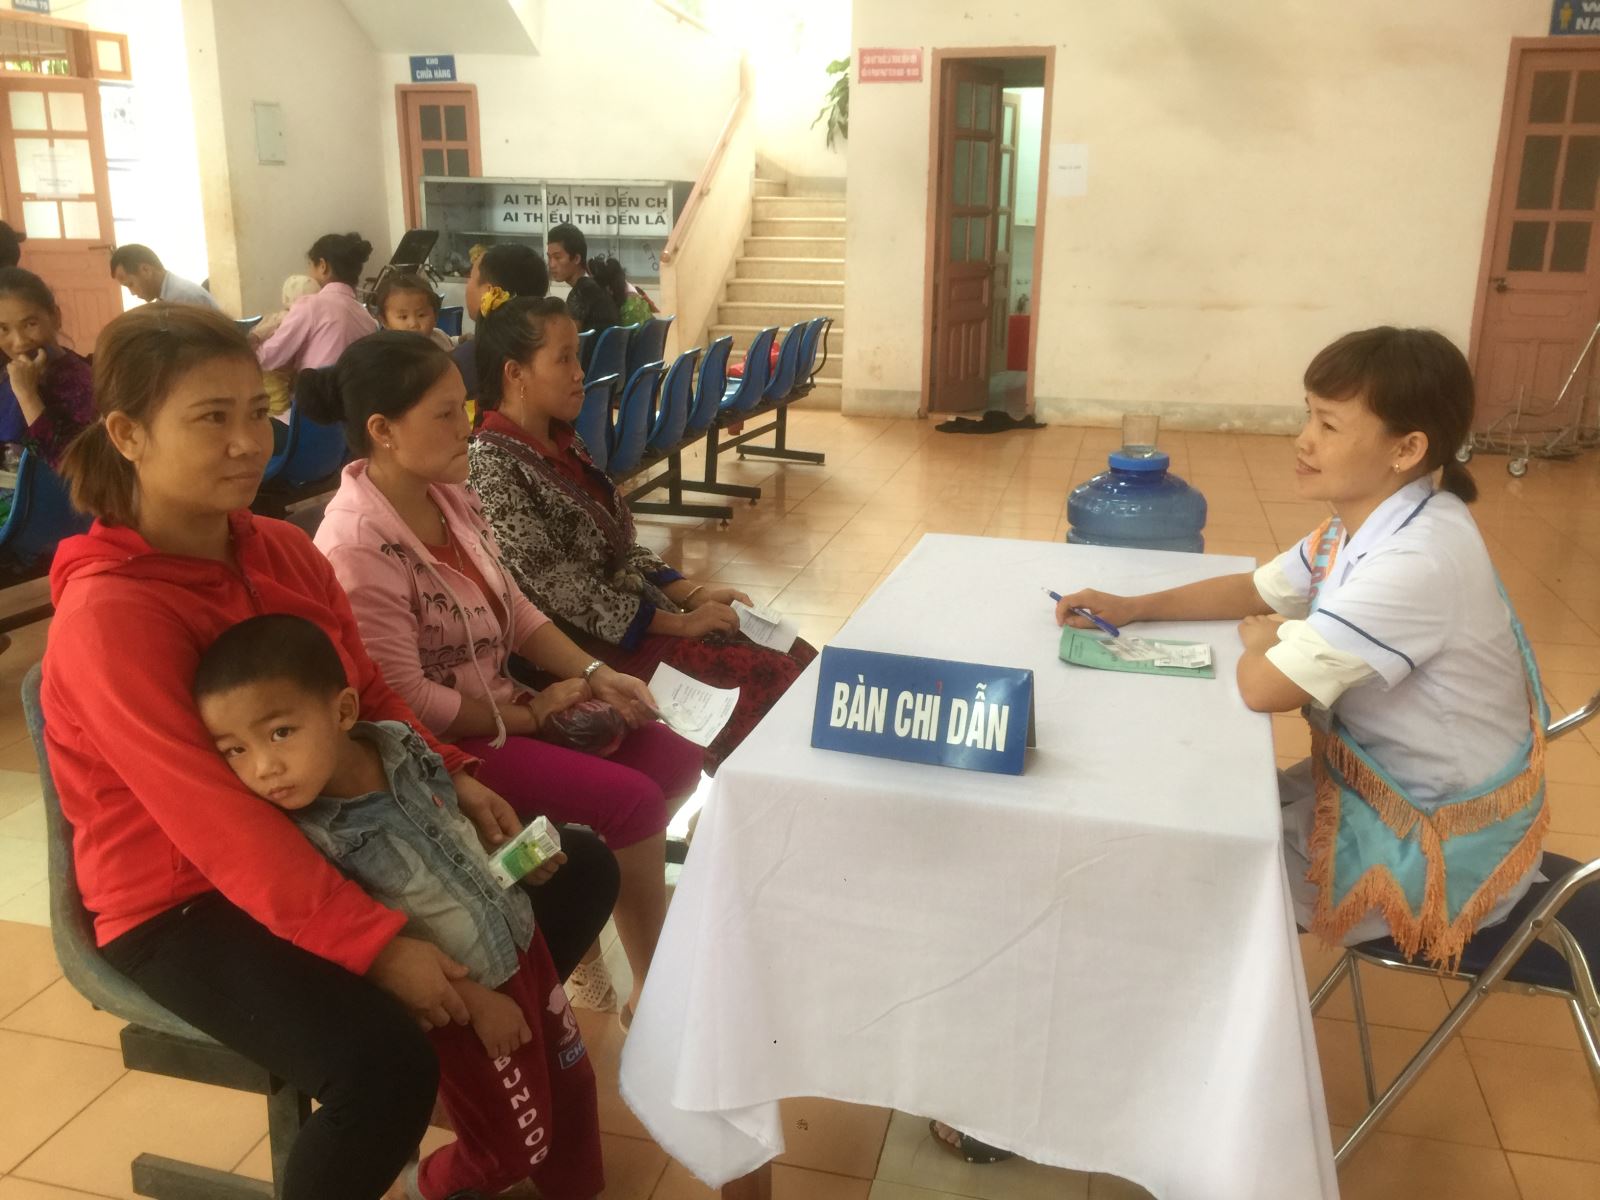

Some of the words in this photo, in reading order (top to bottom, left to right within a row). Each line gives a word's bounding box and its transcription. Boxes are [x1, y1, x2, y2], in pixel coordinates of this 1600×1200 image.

[503, 194, 518, 205] AI
[574, 193, 600, 207] THÌ
[503, 212, 518, 223] AI
[523, 209, 570, 224] THẾU
[575, 211, 601, 225] THÌ
[830, 674, 888, 734] BÀN
[894, 680, 943, 742] CHỈ
[946, 683, 1010, 752] DẪN
[566, 1039, 585, 1062] CH
